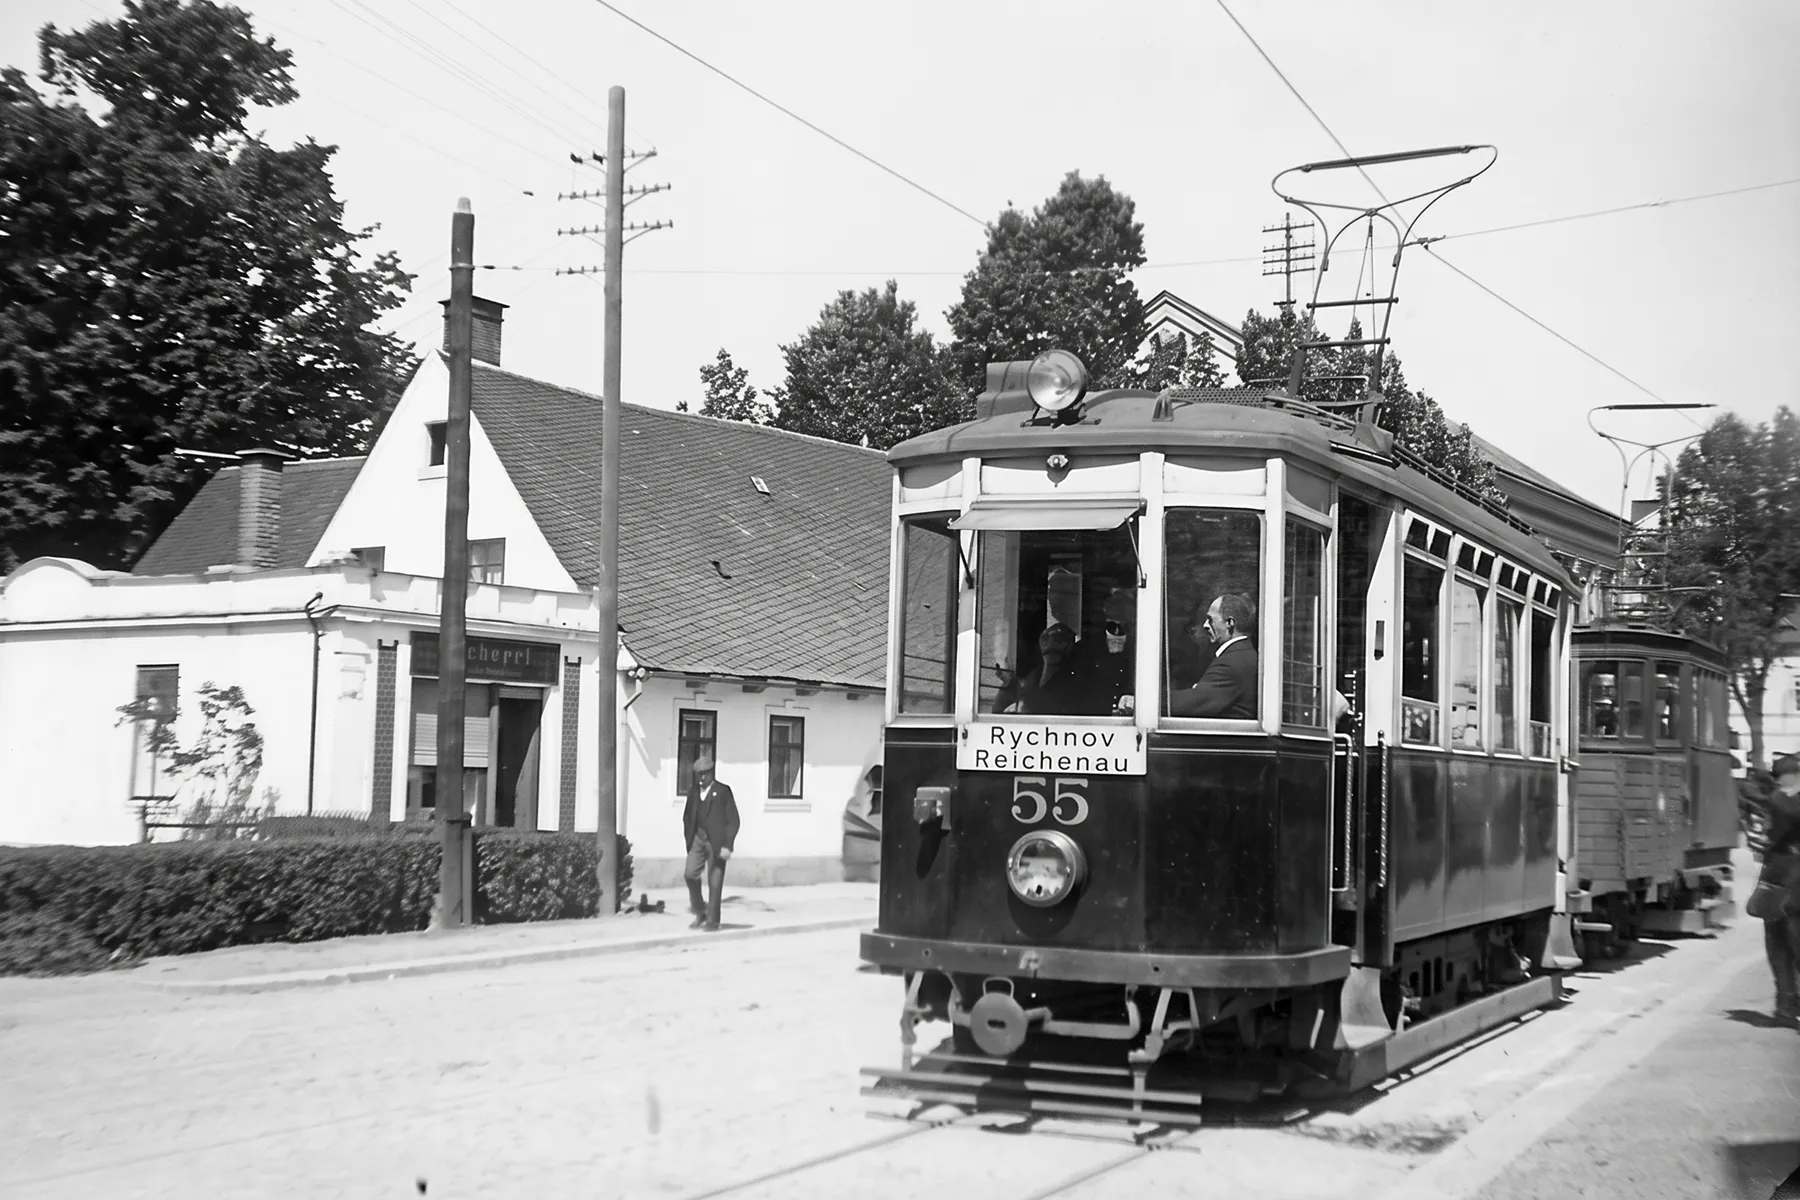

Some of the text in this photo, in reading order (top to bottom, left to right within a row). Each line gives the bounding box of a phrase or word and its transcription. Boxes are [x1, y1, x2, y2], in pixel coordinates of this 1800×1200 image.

[991, 726, 1115, 749] Rychnov
[976, 750, 1128, 772] Reichenau
[1011, 776, 1089, 825] 55
